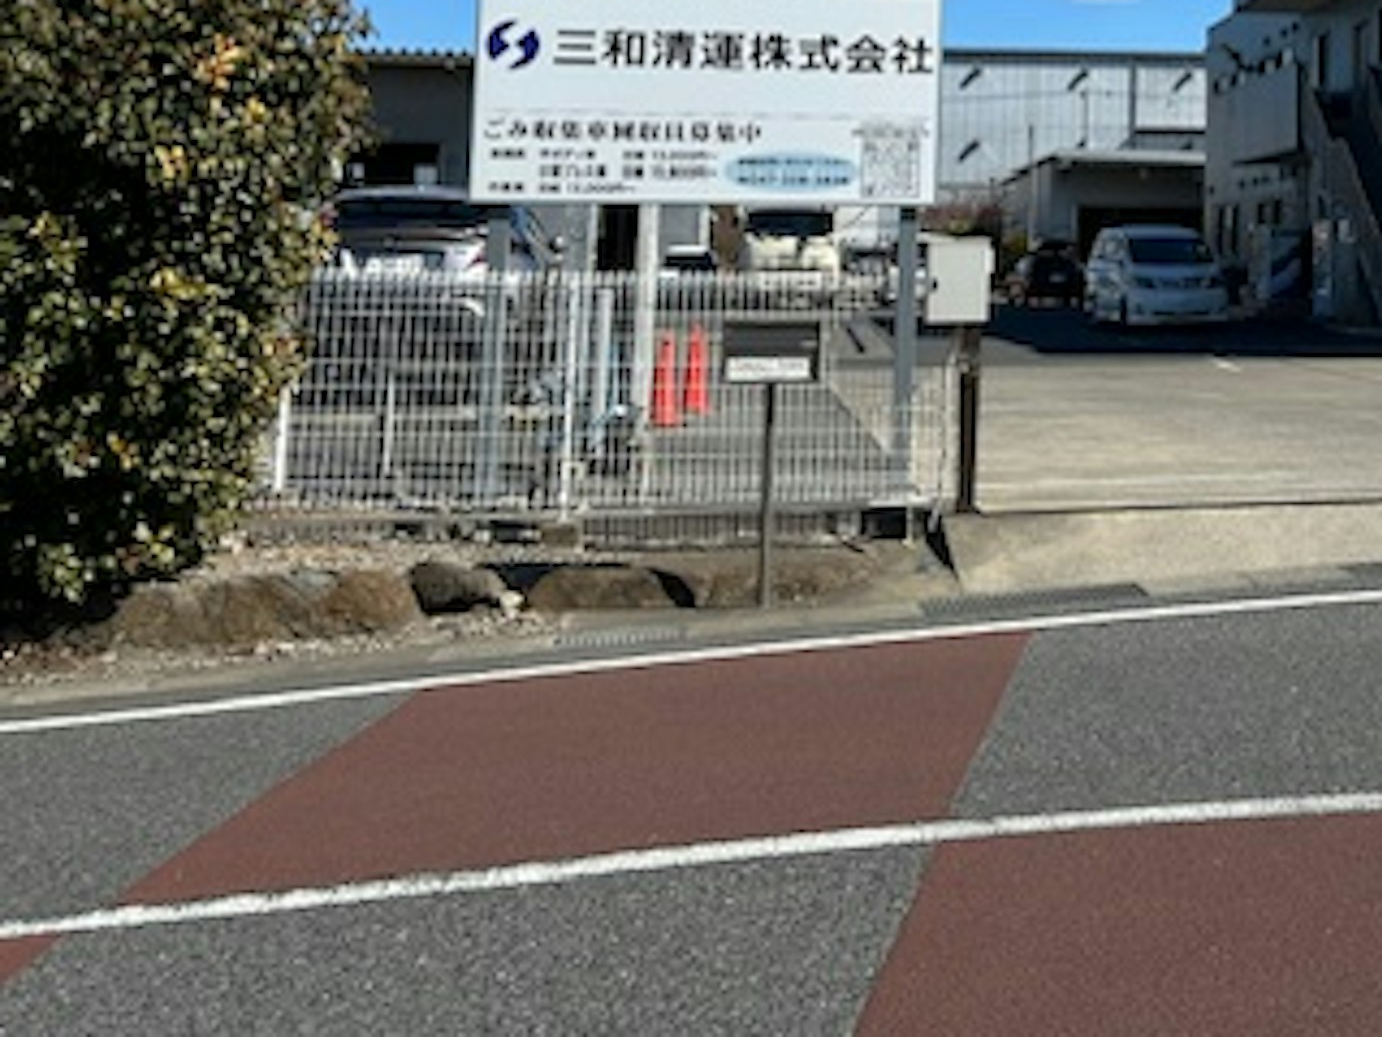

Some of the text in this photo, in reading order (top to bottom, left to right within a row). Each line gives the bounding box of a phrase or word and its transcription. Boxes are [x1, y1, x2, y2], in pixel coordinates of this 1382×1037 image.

[553, 29, 935, 75] 三和清運株式会社
